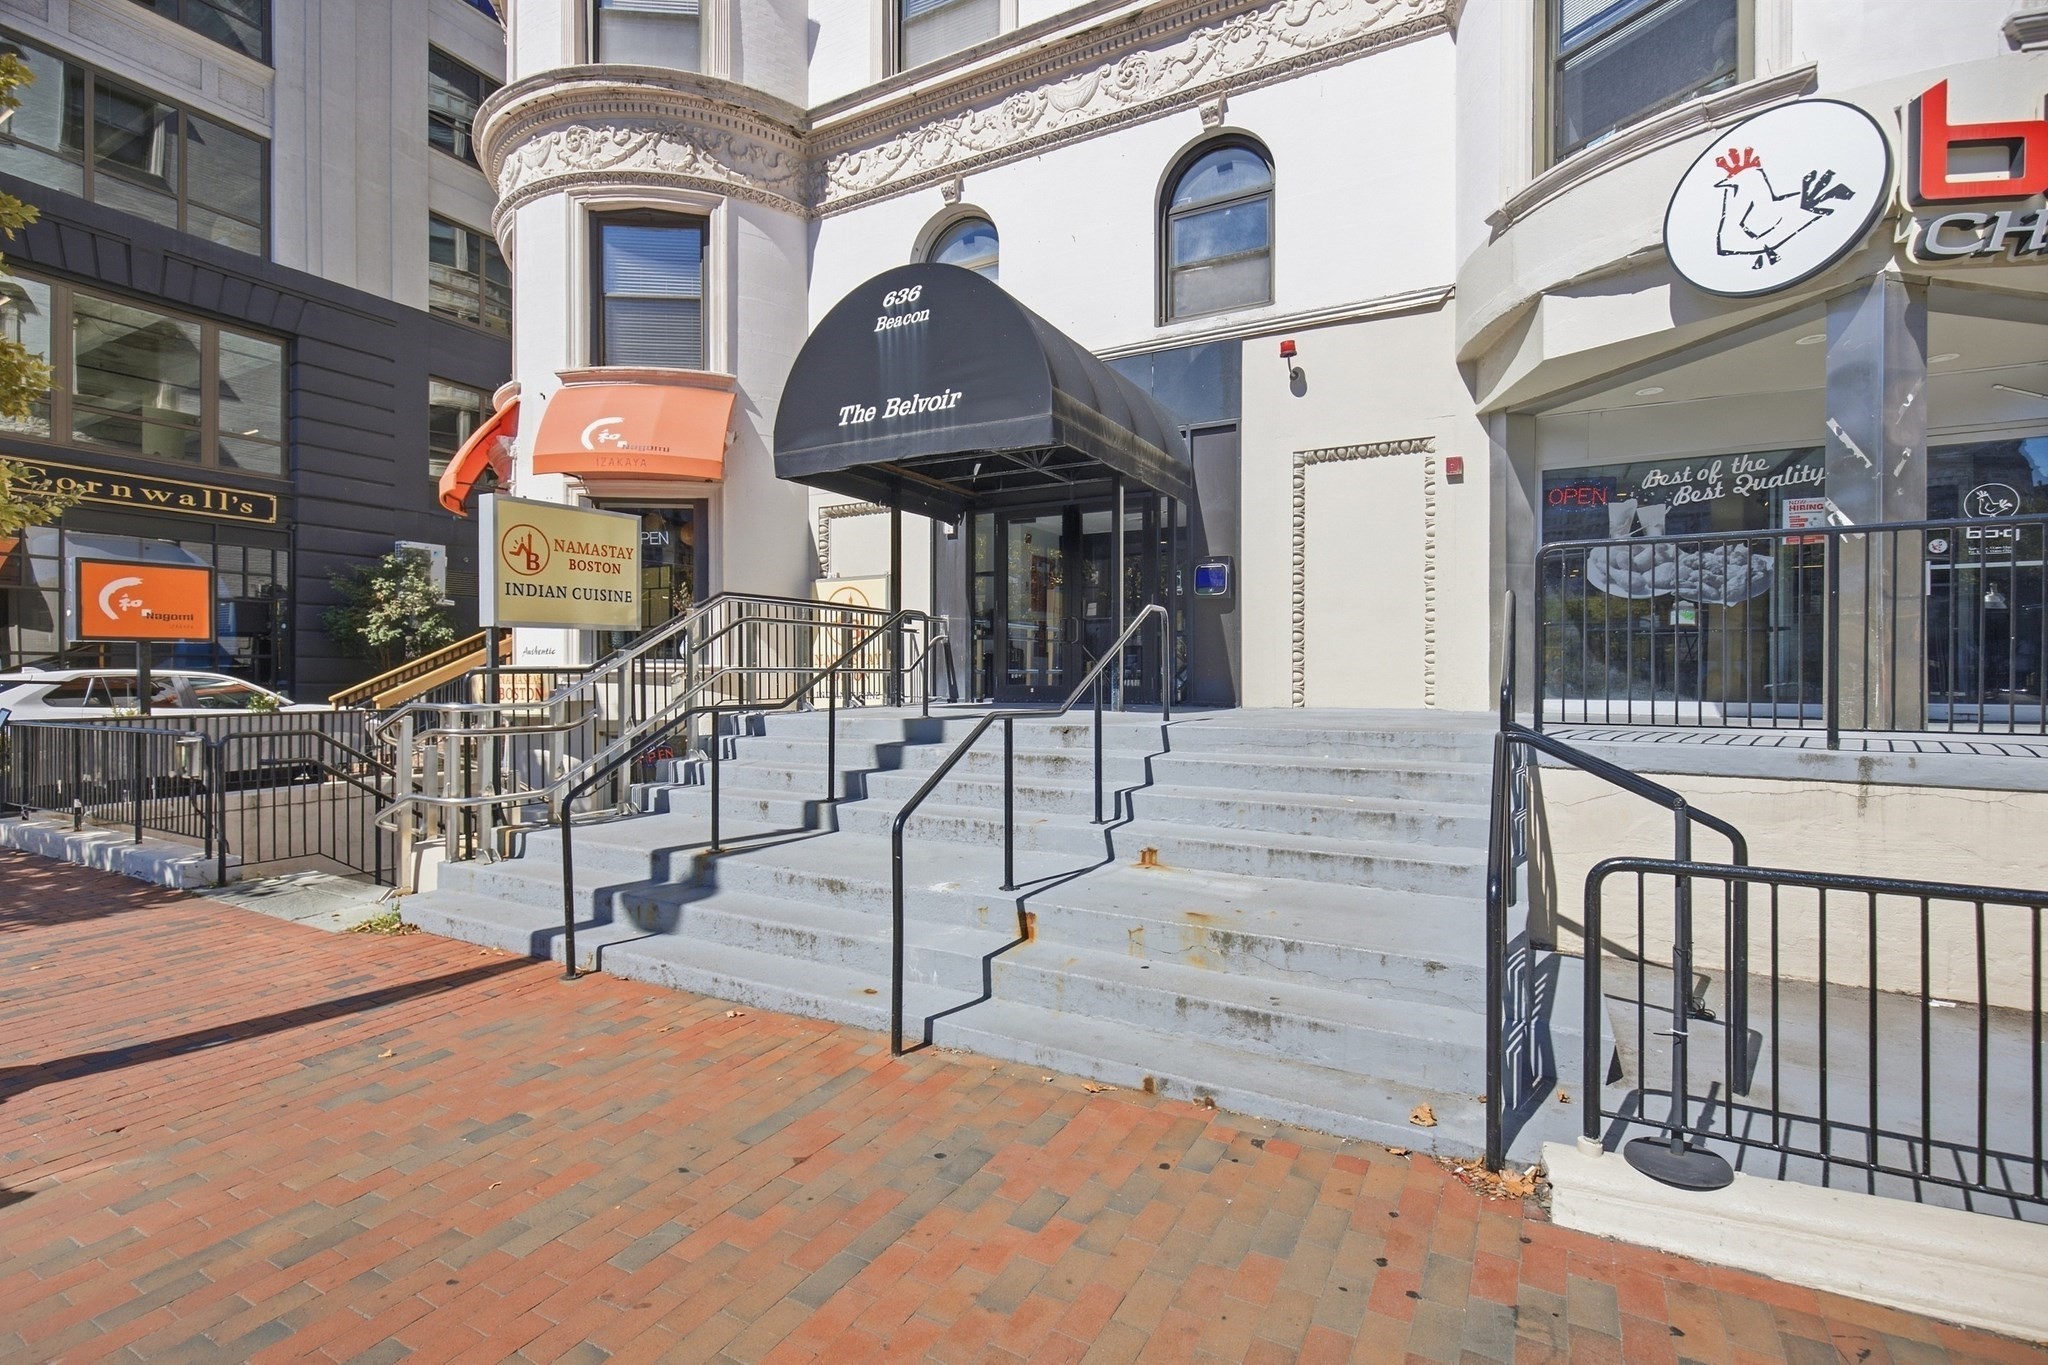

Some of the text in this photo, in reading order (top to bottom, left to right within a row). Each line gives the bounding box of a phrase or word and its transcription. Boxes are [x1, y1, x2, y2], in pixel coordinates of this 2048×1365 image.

[883, 285, 922, 308] 636
[874, 308, 930, 333] Beacon
[838, 389, 962, 427] The Belvoir
[595, 457, 647, 468] IZAKAYA
[1642, 454, 1770, 489] Best of the
[1673, 464, 1827, 507] Best Quality
[1549, 486, 1608, 506] OPEN
[1788, 503, 1824, 511] HIRING
[641, 531, 670, 546] PEN
[553, 538, 634, 560] NAMASTAY
[568, 558, 622, 575] BOSTON
[504, 582, 633, 604] INDIAN CUISINE
[146, 612, 194, 622] Nagomi
[522, 645, 557, 657] Authentic
[647, 746, 674, 763] PEN
